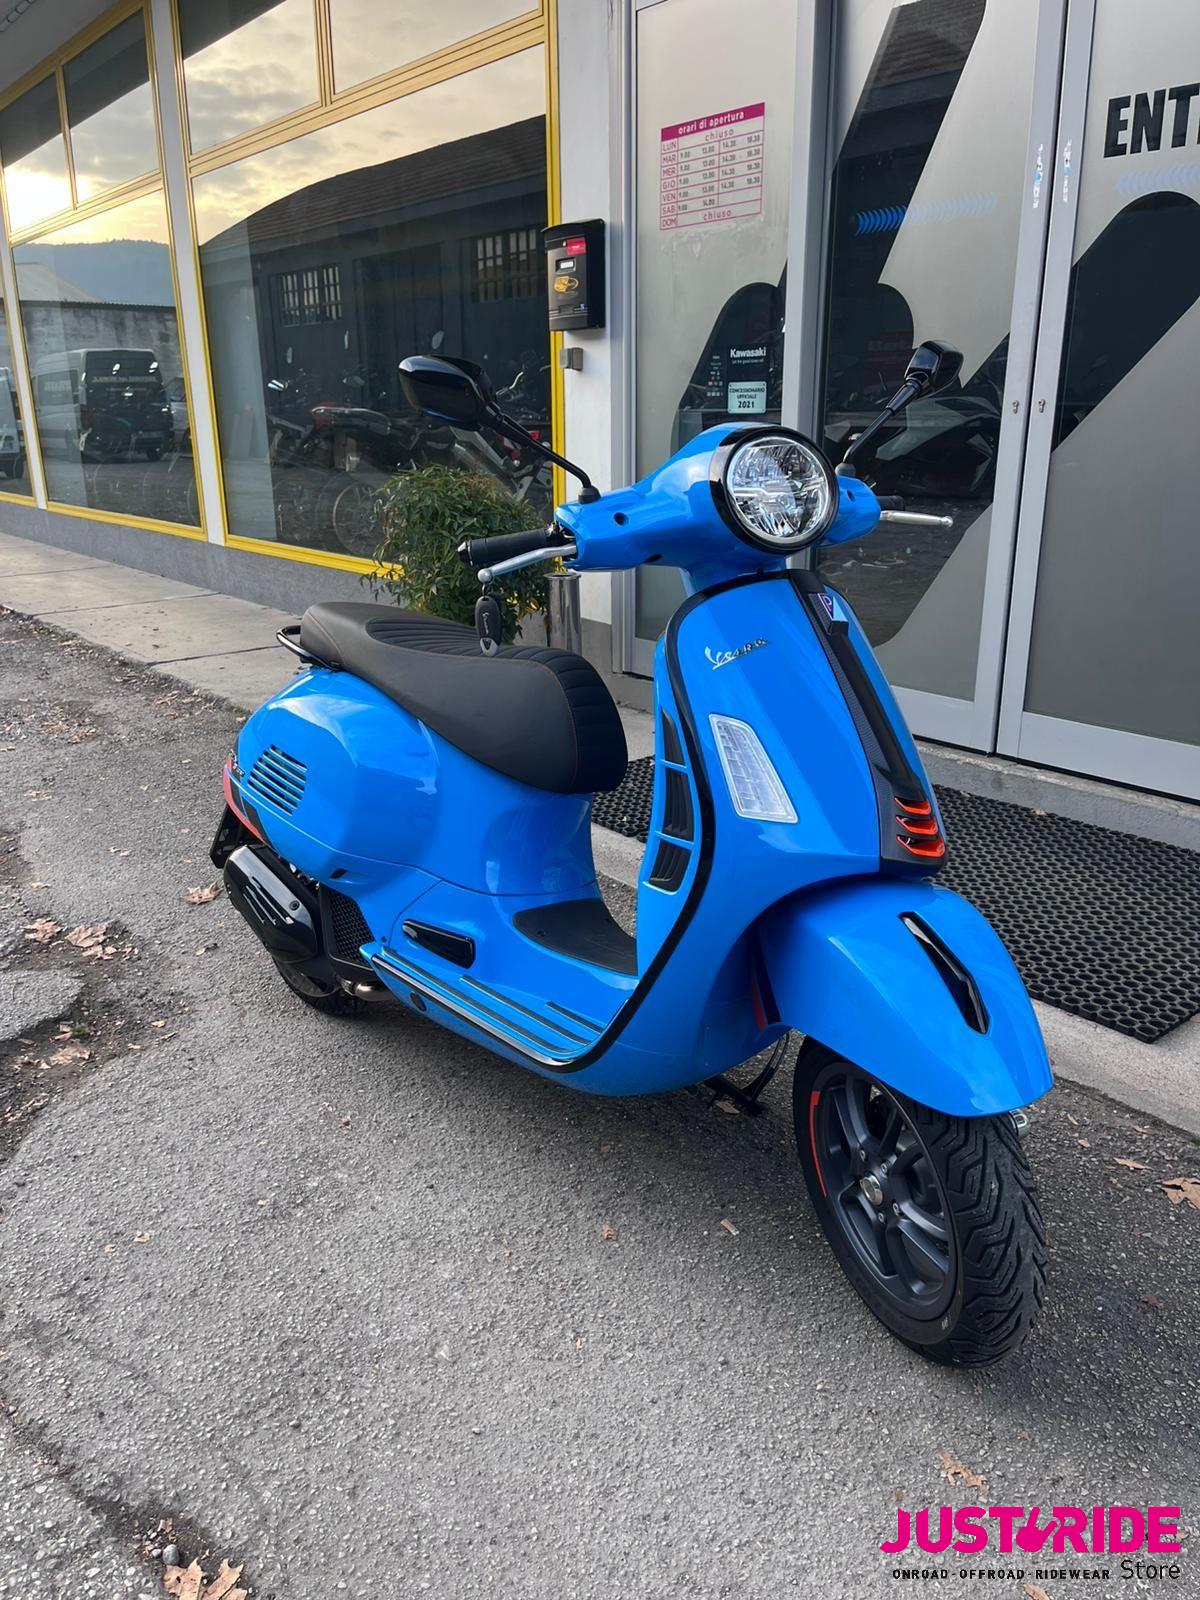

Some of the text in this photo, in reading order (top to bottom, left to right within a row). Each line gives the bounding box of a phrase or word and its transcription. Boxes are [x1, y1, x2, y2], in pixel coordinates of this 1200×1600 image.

[678, 111, 744, 135] orari di apertura
[1103, 83, 1200, 158] ENT
[662, 128, 734, 152] LUN chiuso
[662, 154, 677, 164] MAR
[662, 167, 676, 176] MER
[662, 180, 676, 190] GIO
[662, 193, 676, 202] VEN
[662, 206, 675, 215] SAB
[662, 210, 732, 227] DOM chiuso
[730, 347, 766, 358] Kawasaki
